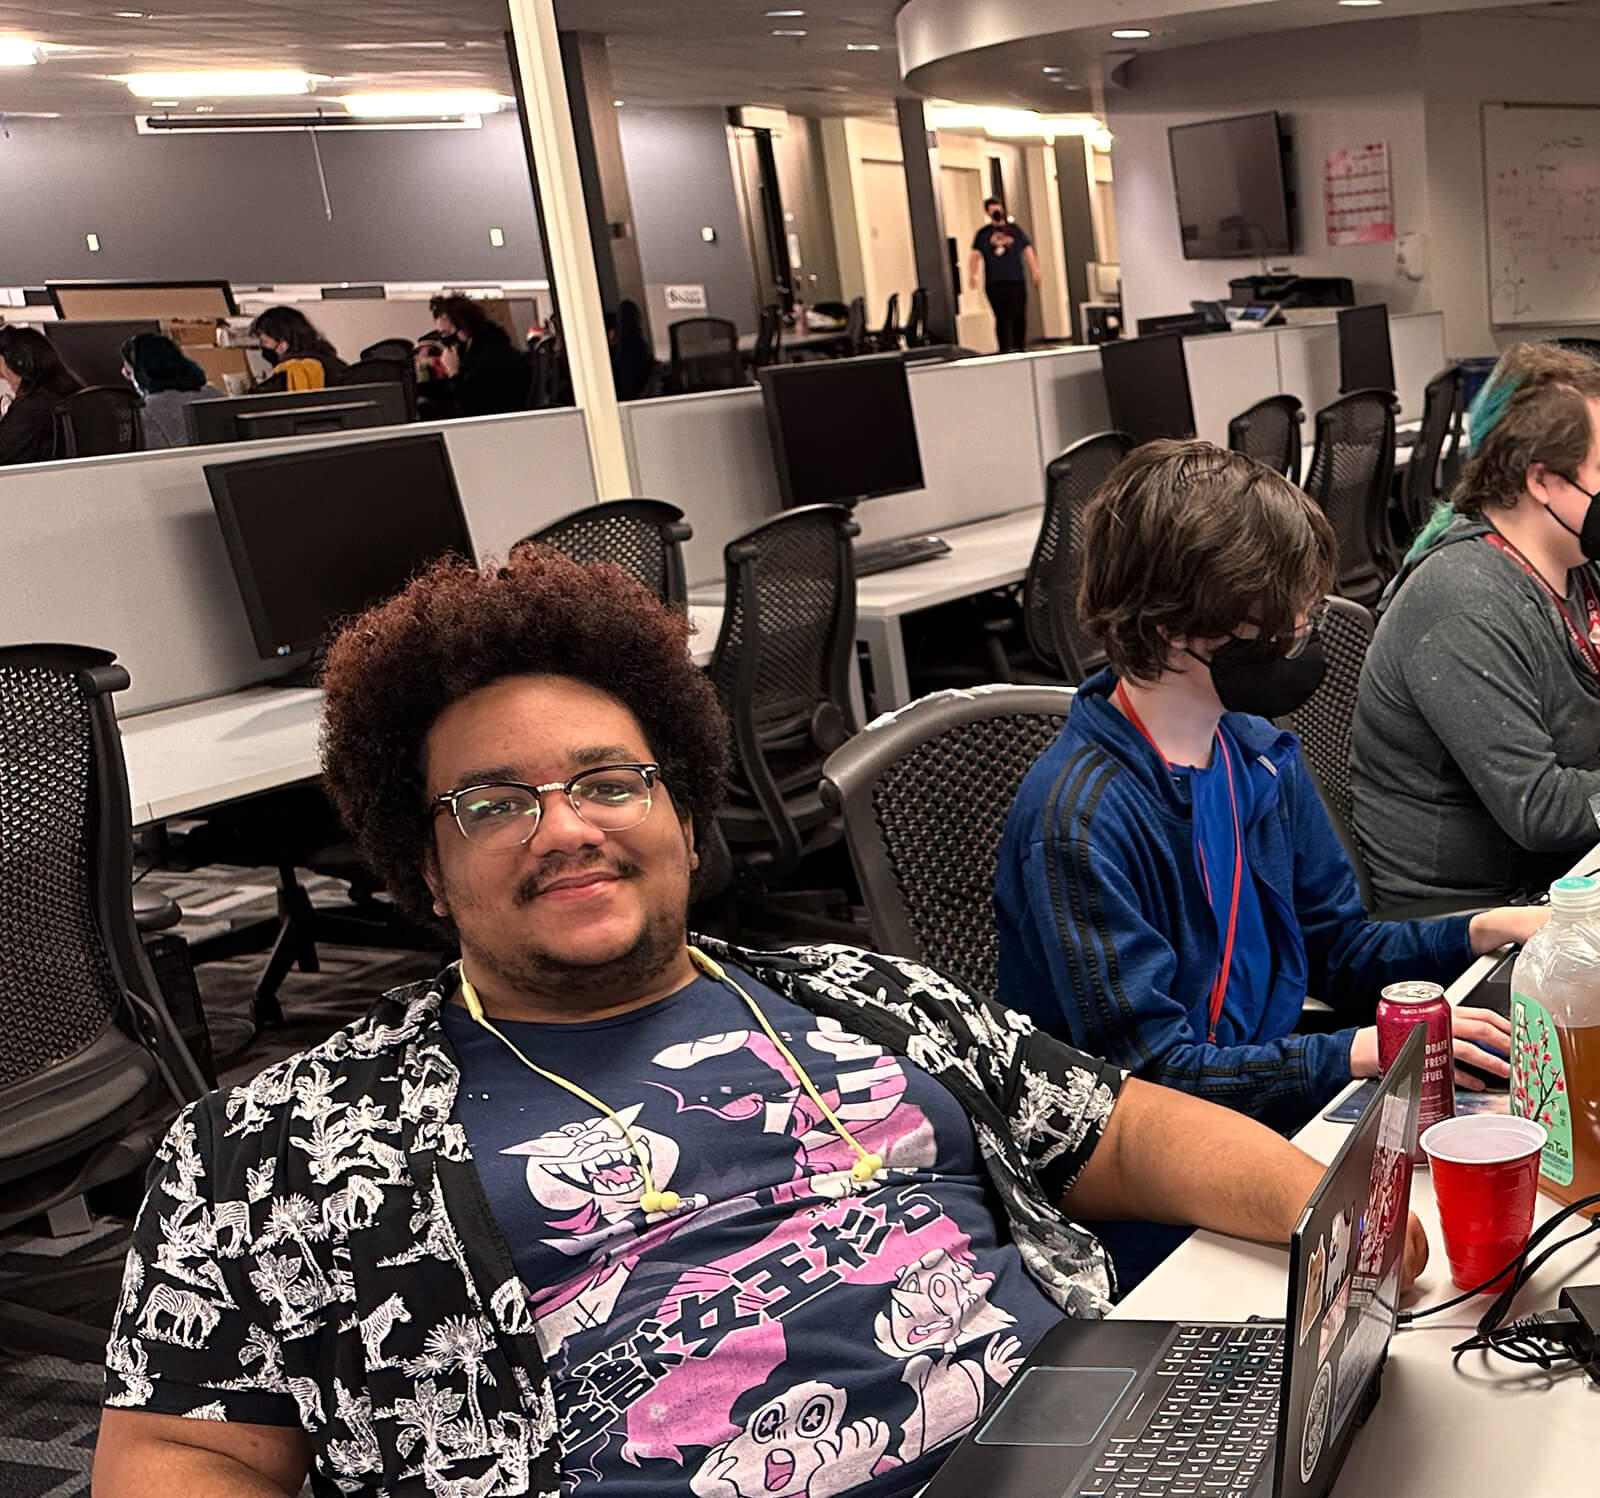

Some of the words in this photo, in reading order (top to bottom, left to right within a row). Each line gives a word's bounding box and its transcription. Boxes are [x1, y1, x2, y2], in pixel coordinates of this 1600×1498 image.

[1425, 1040, 1448, 1054] DRATE
[1425, 1055, 1448, 1069] FRESH
[1422, 1069, 1443, 1083] EFUEL
[1553, 1139, 1569, 1159] Tea
